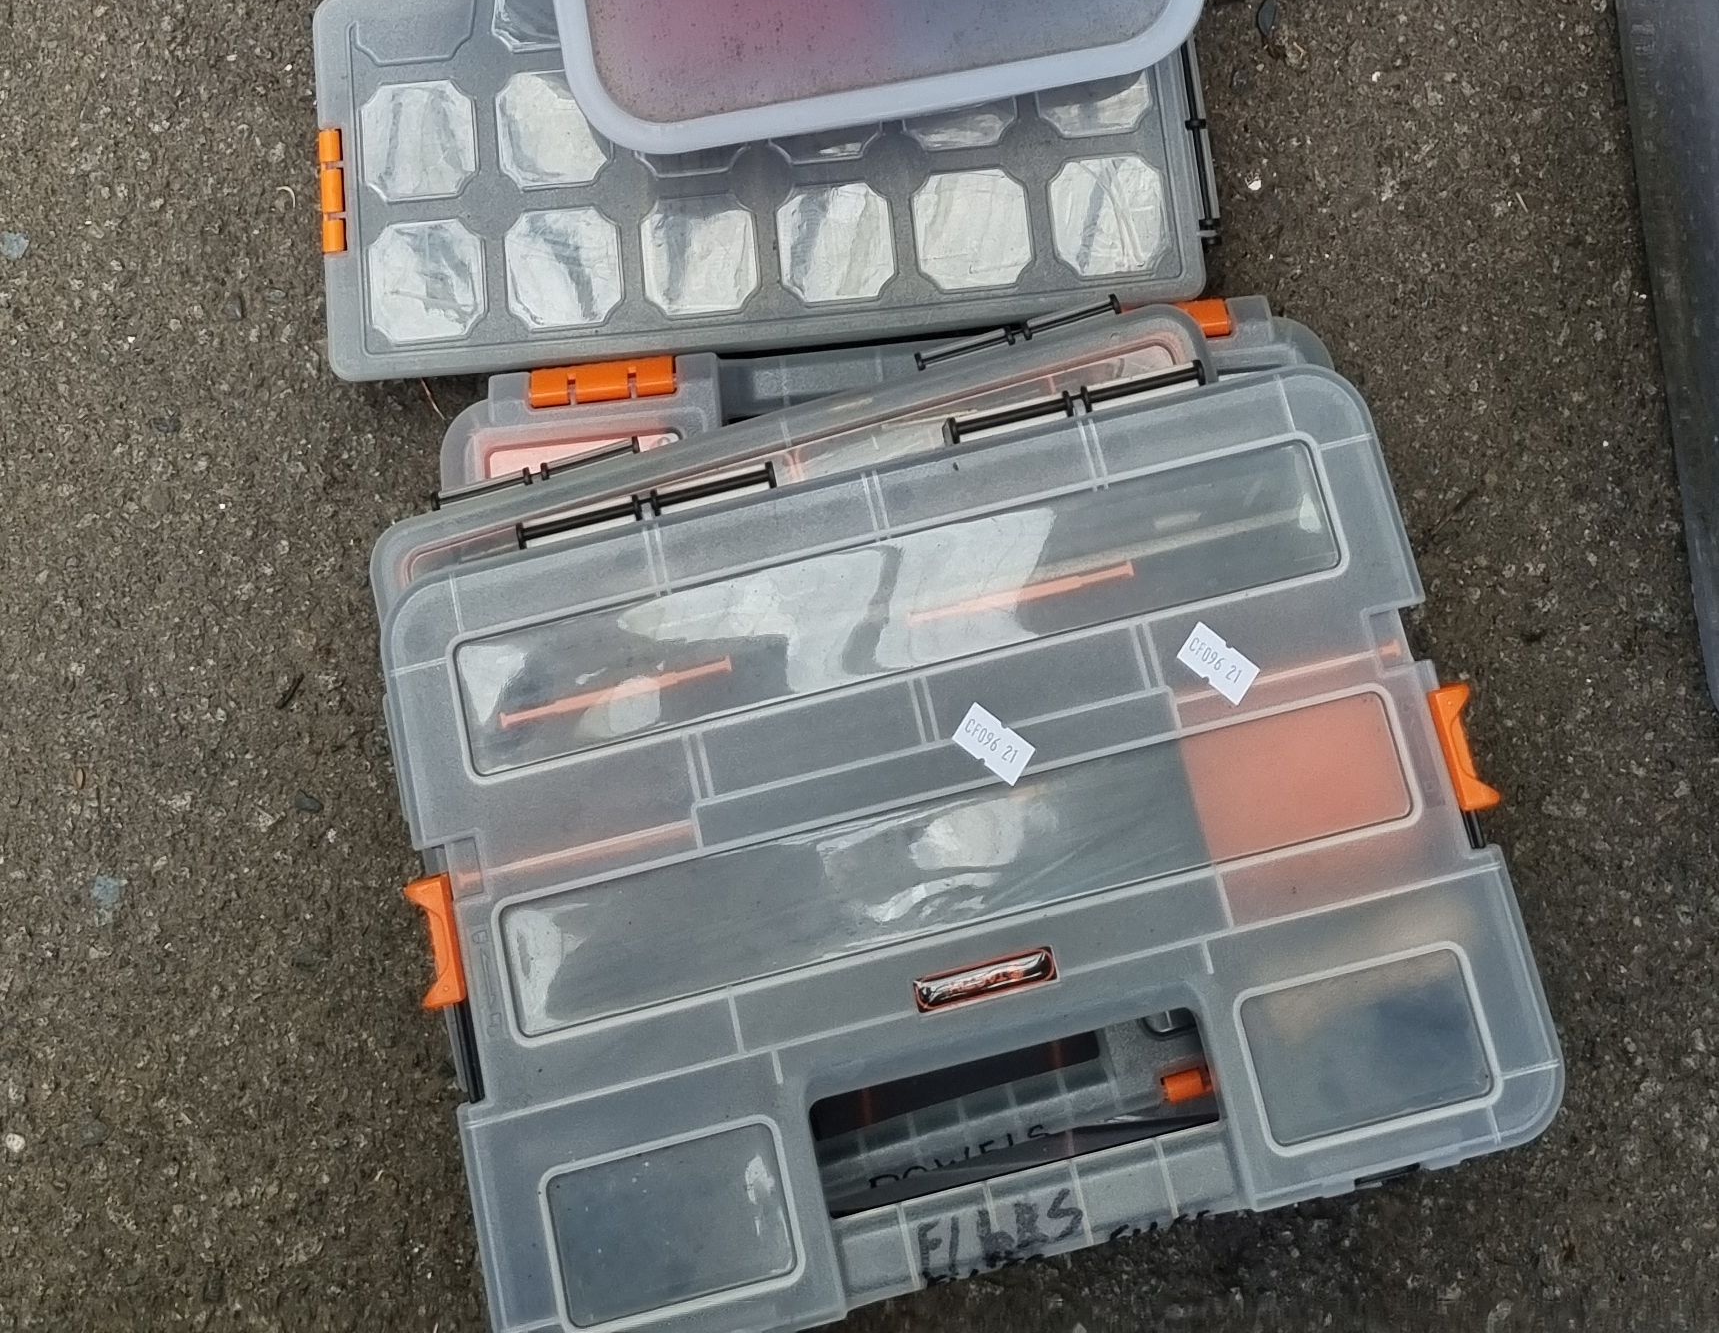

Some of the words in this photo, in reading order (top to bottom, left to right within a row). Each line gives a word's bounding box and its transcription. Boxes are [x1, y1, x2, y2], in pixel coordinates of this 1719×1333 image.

[1188, 636, 1223, 671] CF096
[1225, 663, 1244, 684] 21
[964, 718, 998, 752] CF096
[1001, 743, 1020, 764] 21
